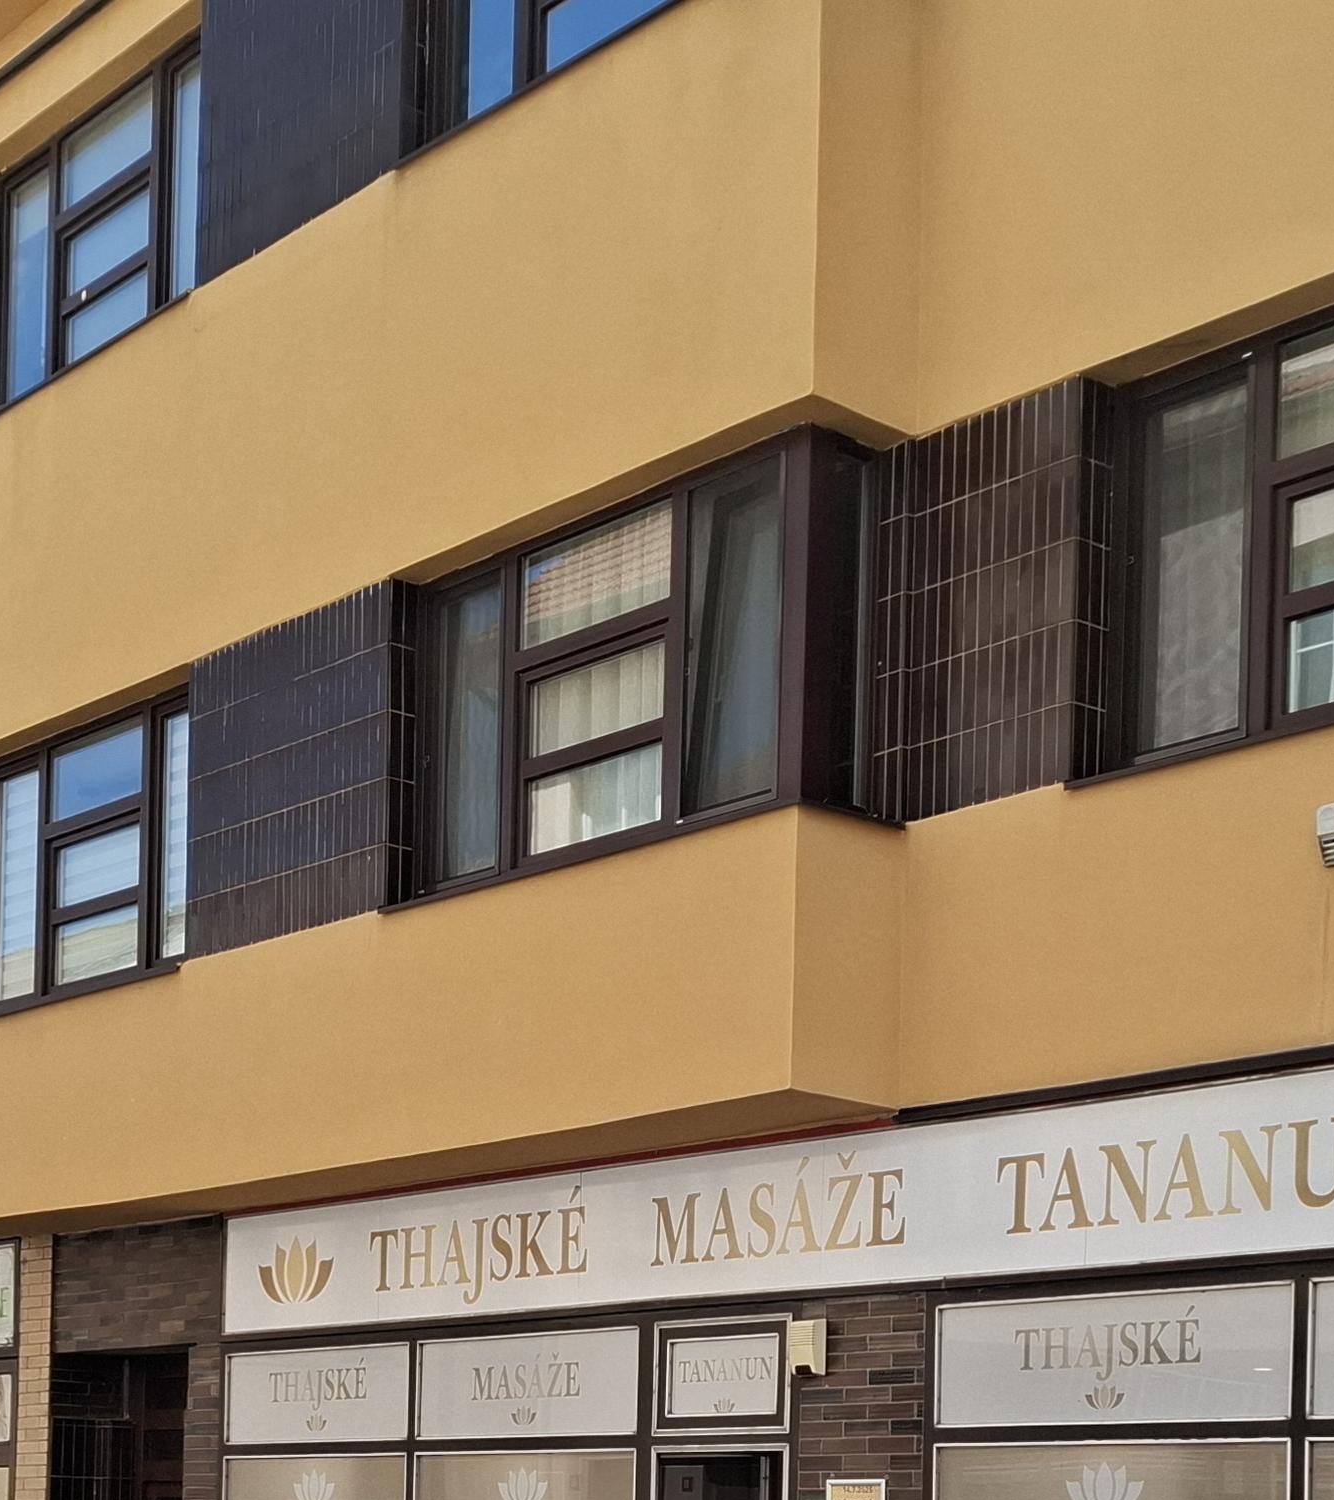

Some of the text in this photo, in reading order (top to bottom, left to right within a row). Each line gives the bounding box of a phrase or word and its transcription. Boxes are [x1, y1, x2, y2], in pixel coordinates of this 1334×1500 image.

[369, 1186, 589, 1304] THAJSKÉ
[650, 1150, 907, 1268] MASÁŽE
[678, 1356, 775, 1384] TANANUN
[1014, 1305, 1202, 1381] THAJSKÉ
[269, 1357, 368, 1411] THAJSKÉ
[471, 1353, 581, 1401] MASÁŽE
